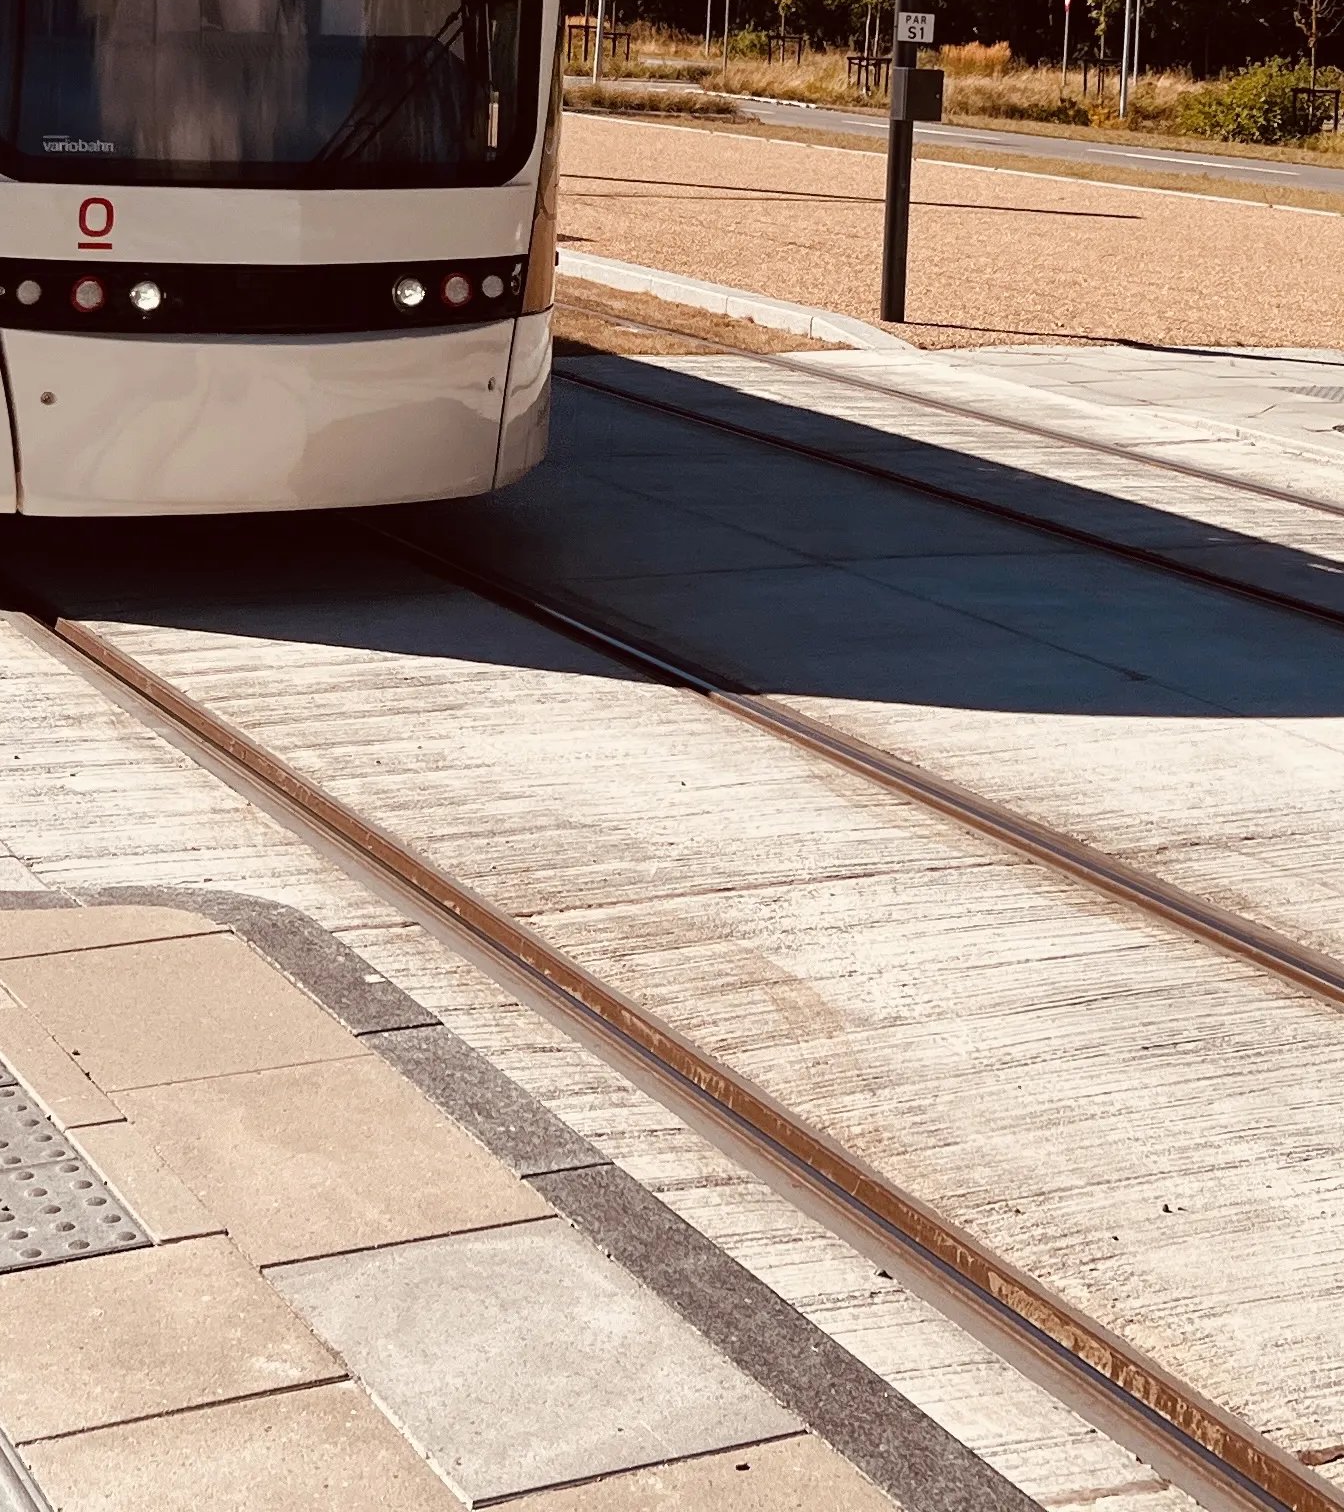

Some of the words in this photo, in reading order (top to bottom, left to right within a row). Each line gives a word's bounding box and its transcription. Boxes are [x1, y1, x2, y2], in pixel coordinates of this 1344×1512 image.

[906, 15, 927, 24] PAR
[908, 26, 924, 39] S1
[42, 138, 115, 152] variobahn
